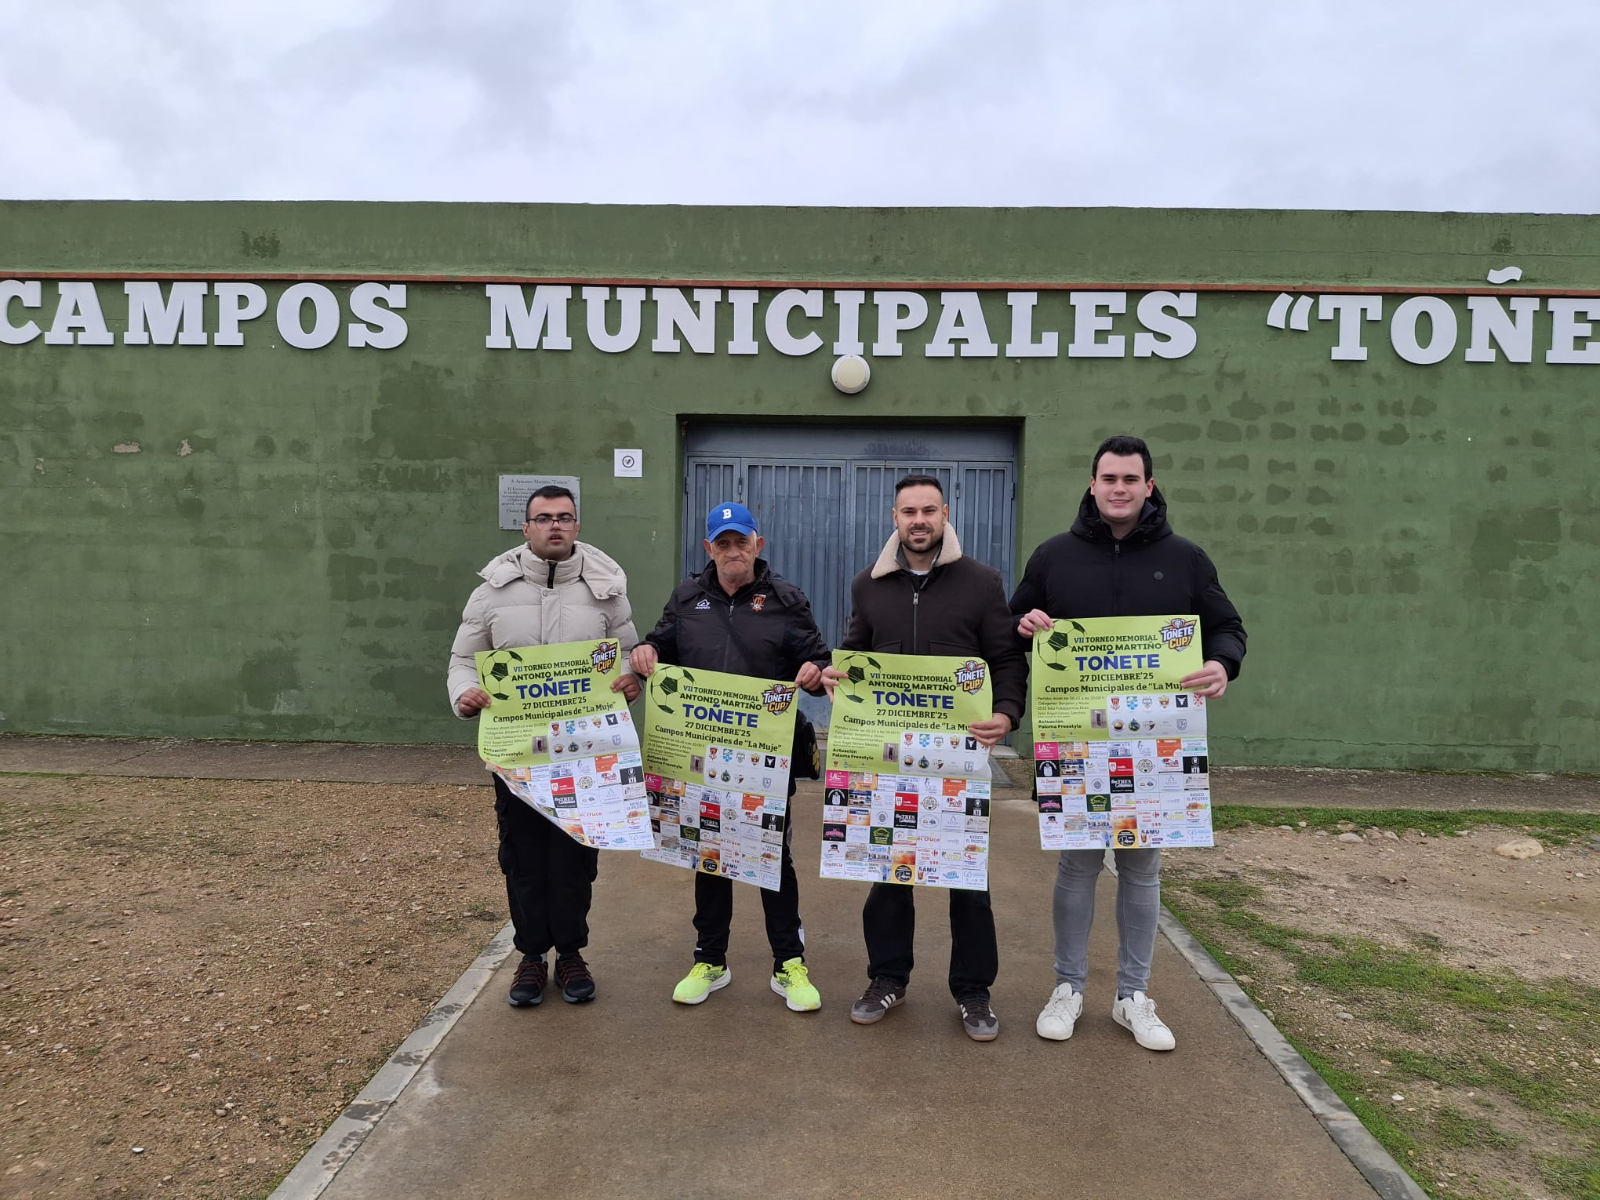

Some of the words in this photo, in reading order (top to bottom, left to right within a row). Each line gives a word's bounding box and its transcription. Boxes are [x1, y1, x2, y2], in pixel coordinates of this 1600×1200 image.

[0, 280, 408, 350] CAMPOS
[485, 284, 1198, 359] MUNICIPALES
[722, 508, 732, 520] B
[1116, 634, 1157, 642] MEMORIAL
[1162, 626, 1194, 641] TOÑETE
[1071, 644, 1113, 652] ANTONIO
[1115, 640, 1162, 650] MARTIÑO
[592, 649, 616, 663] TOÑETE
[1075, 650, 1160, 671] TOÑETE
[523, 663, 552, 672] TORNEO
[554, 659, 589, 668] MEMORIAL
[512, 671, 551, 682] ANTONIO
[554, 666, 592, 677] MARTIÑO
[957, 669, 984, 682] TOÑETE
[1091, 672, 1154, 681] DICIEMBRE'25
[516, 678, 591, 699] TOÑETE
[868, 681, 910, 690] ANTONIO
[912, 680, 956, 691] MARTIÑO
[1045, 686, 1079, 694] Campos
[1081, 683, 1134, 694] Municipales
[1136, 683, 1147, 691] de
[680, 693, 720, 705] ANTONIO
[721, 699, 762, 710] MARTIÑO
[694, 687, 722, 696] TORNEO
[723, 690, 759, 702] MEMORIAL
[764, 693, 792, 703] TOÑETE
[872, 688, 954, 709] TOÑETE
[522, 702, 531, 710] 27
[533, 696, 587, 709] DICIEMBRE'25
[493, 714, 523, 723] Campos
[525, 709, 573, 721] Municipales
[683, 703, 759, 728] TOÑETE
[888, 710, 948, 719] DICIEMBRE'25
[696, 722, 751, 737] DICIEMBRE'25
[843, 715, 876, 726] Campos
[877, 719, 928, 731] Municipales
[655, 725, 684, 737] Campos
[685, 731, 732, 745] Municipales
[733, 738, 743, 746] de
